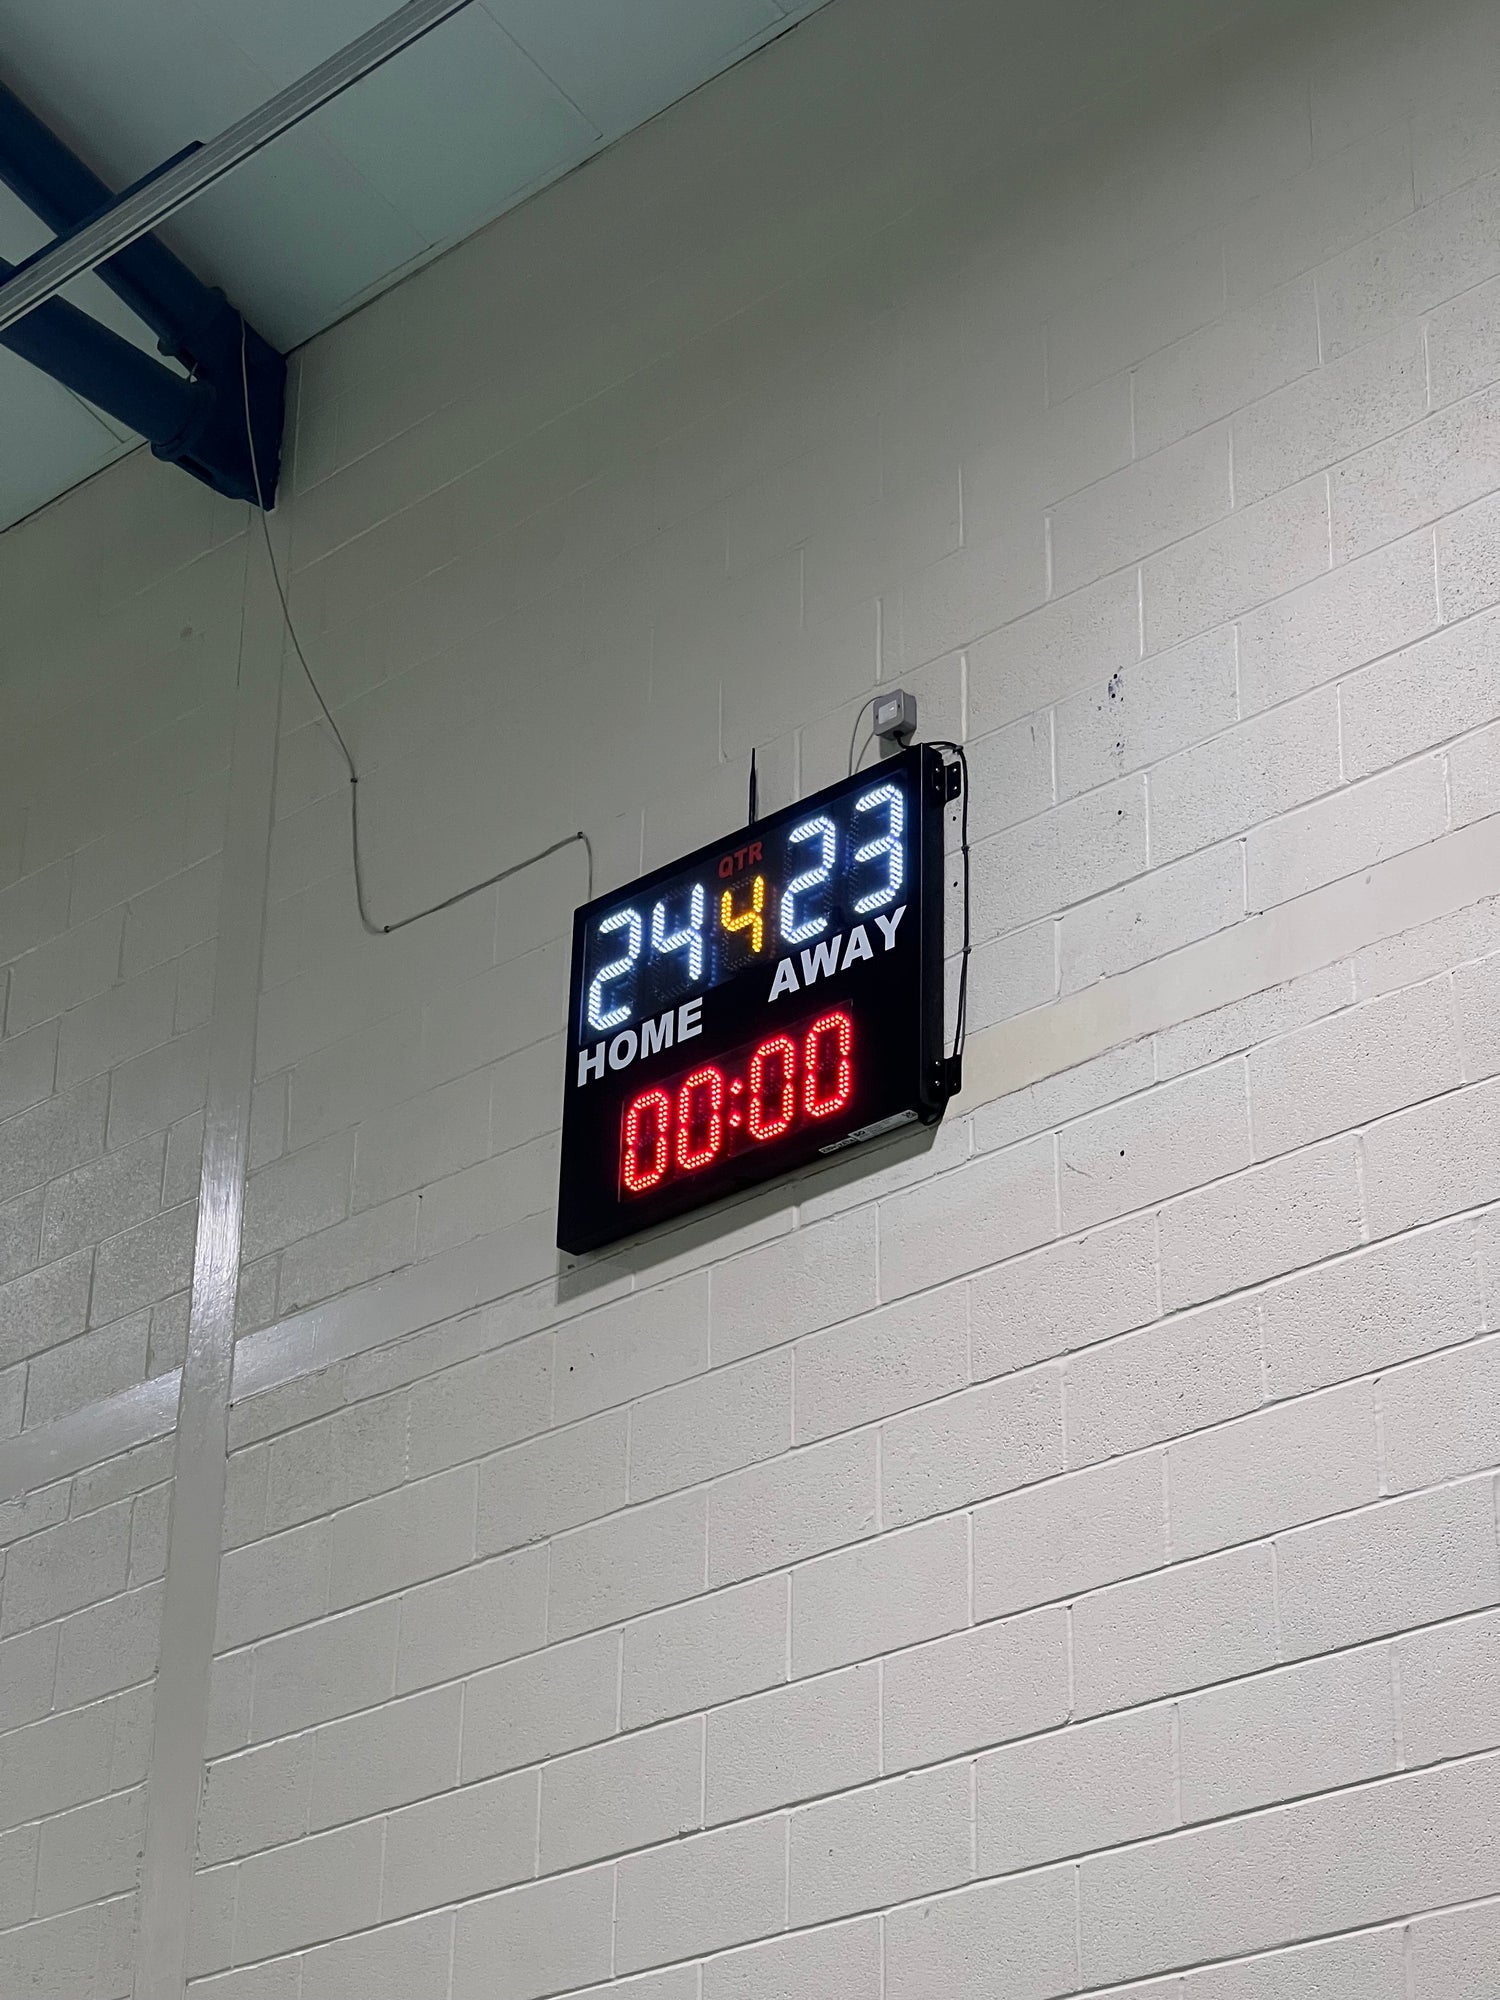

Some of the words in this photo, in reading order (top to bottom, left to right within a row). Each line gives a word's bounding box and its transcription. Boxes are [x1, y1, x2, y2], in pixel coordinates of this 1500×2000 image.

[720, 842, 763, 876] QTR
[780, 784, 903, 943] 23
[587, 884, 703, 1030] 24
[721, 876, 764, 952] 4
[768, 906, 906, 1002] AWAY
[577, 997, 703, 1087] HOME
[624, 1013, 851, 1191] 00:00
